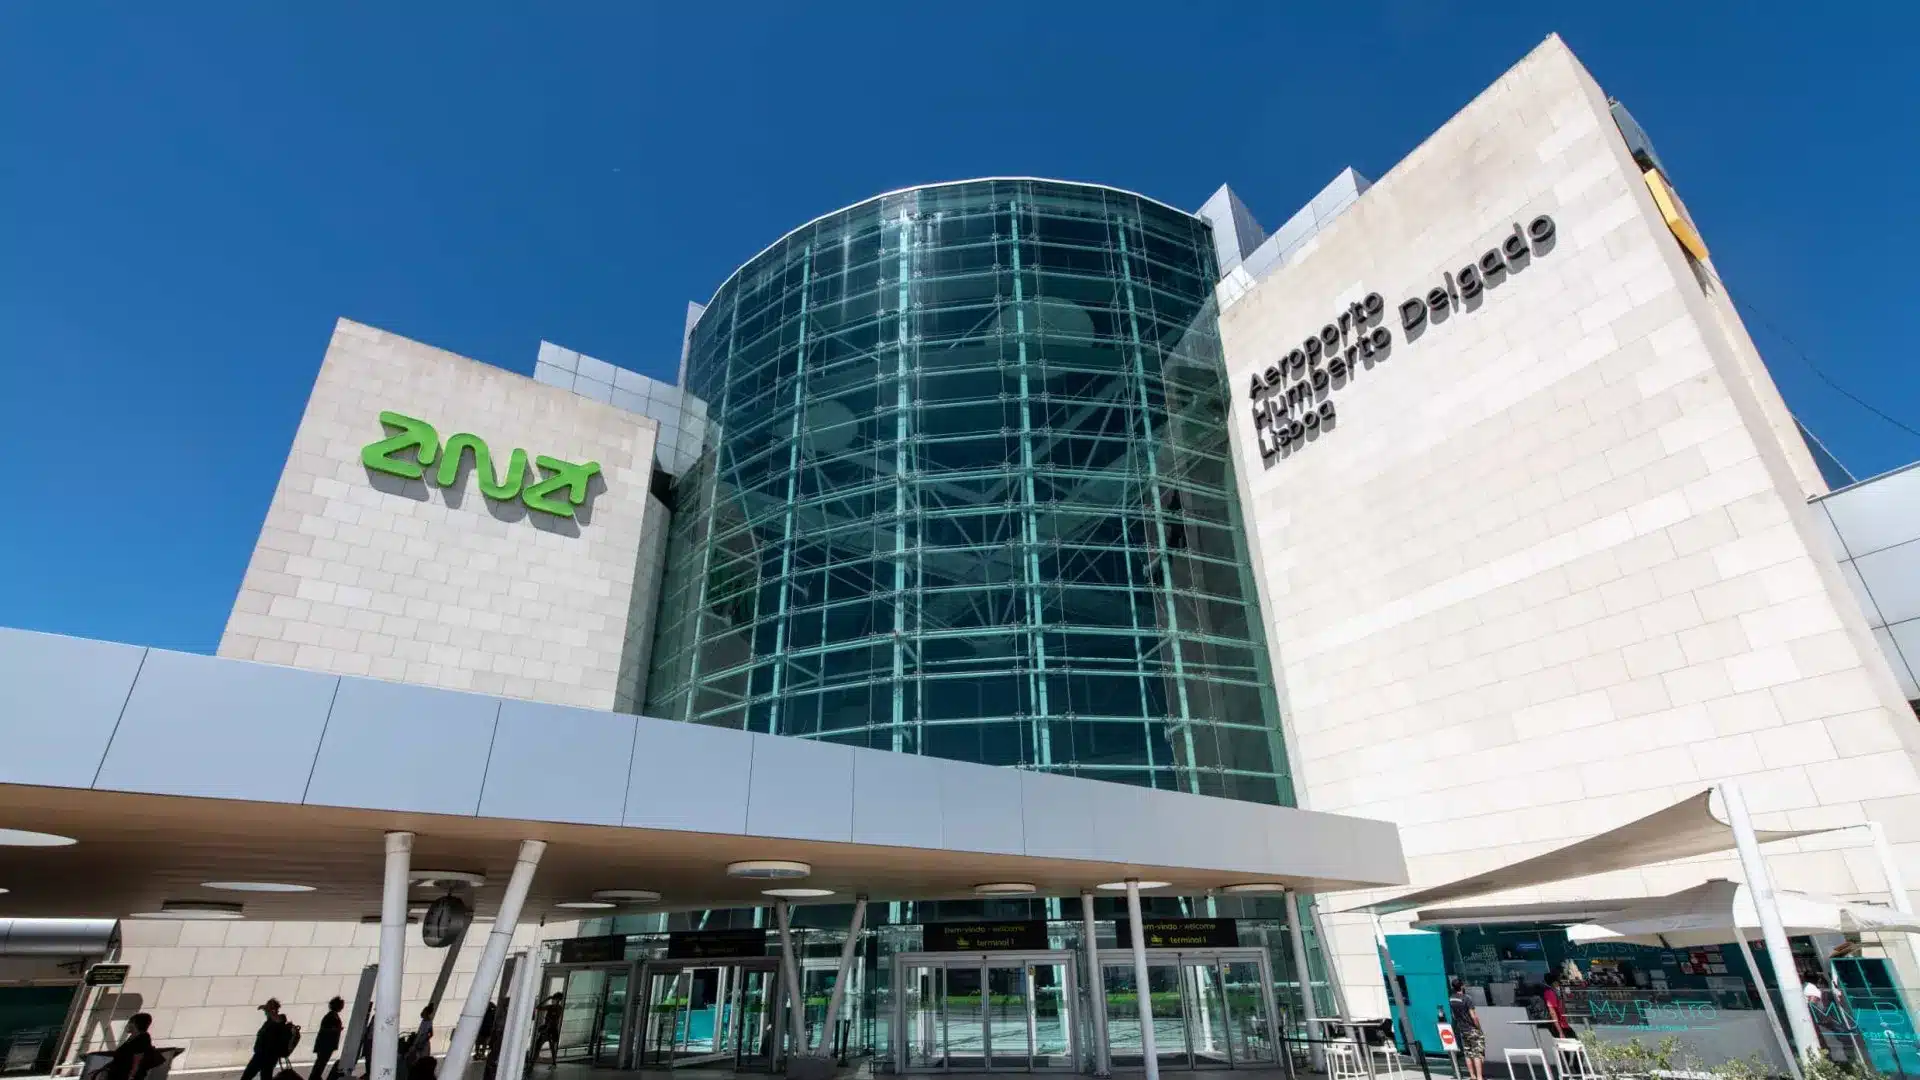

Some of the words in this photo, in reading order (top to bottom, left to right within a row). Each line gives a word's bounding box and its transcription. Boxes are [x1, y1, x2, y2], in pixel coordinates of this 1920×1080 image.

[1252, 326, 1391, 431] Humberto
[1398, 214, 1556, 330] Delgado
[1250, 292, 1384, 400] Aeroporto
[1259, 400, 1336, 460] Lisboa
[1143, 922, 1177, 931] em-vindo
[976, 938, 1009, 947] terminal
[1170, 936, 1202, 944] terminal
[1588, 999, 1626, 1023] My
[1634, 999, 1717, 1020] Bistro
